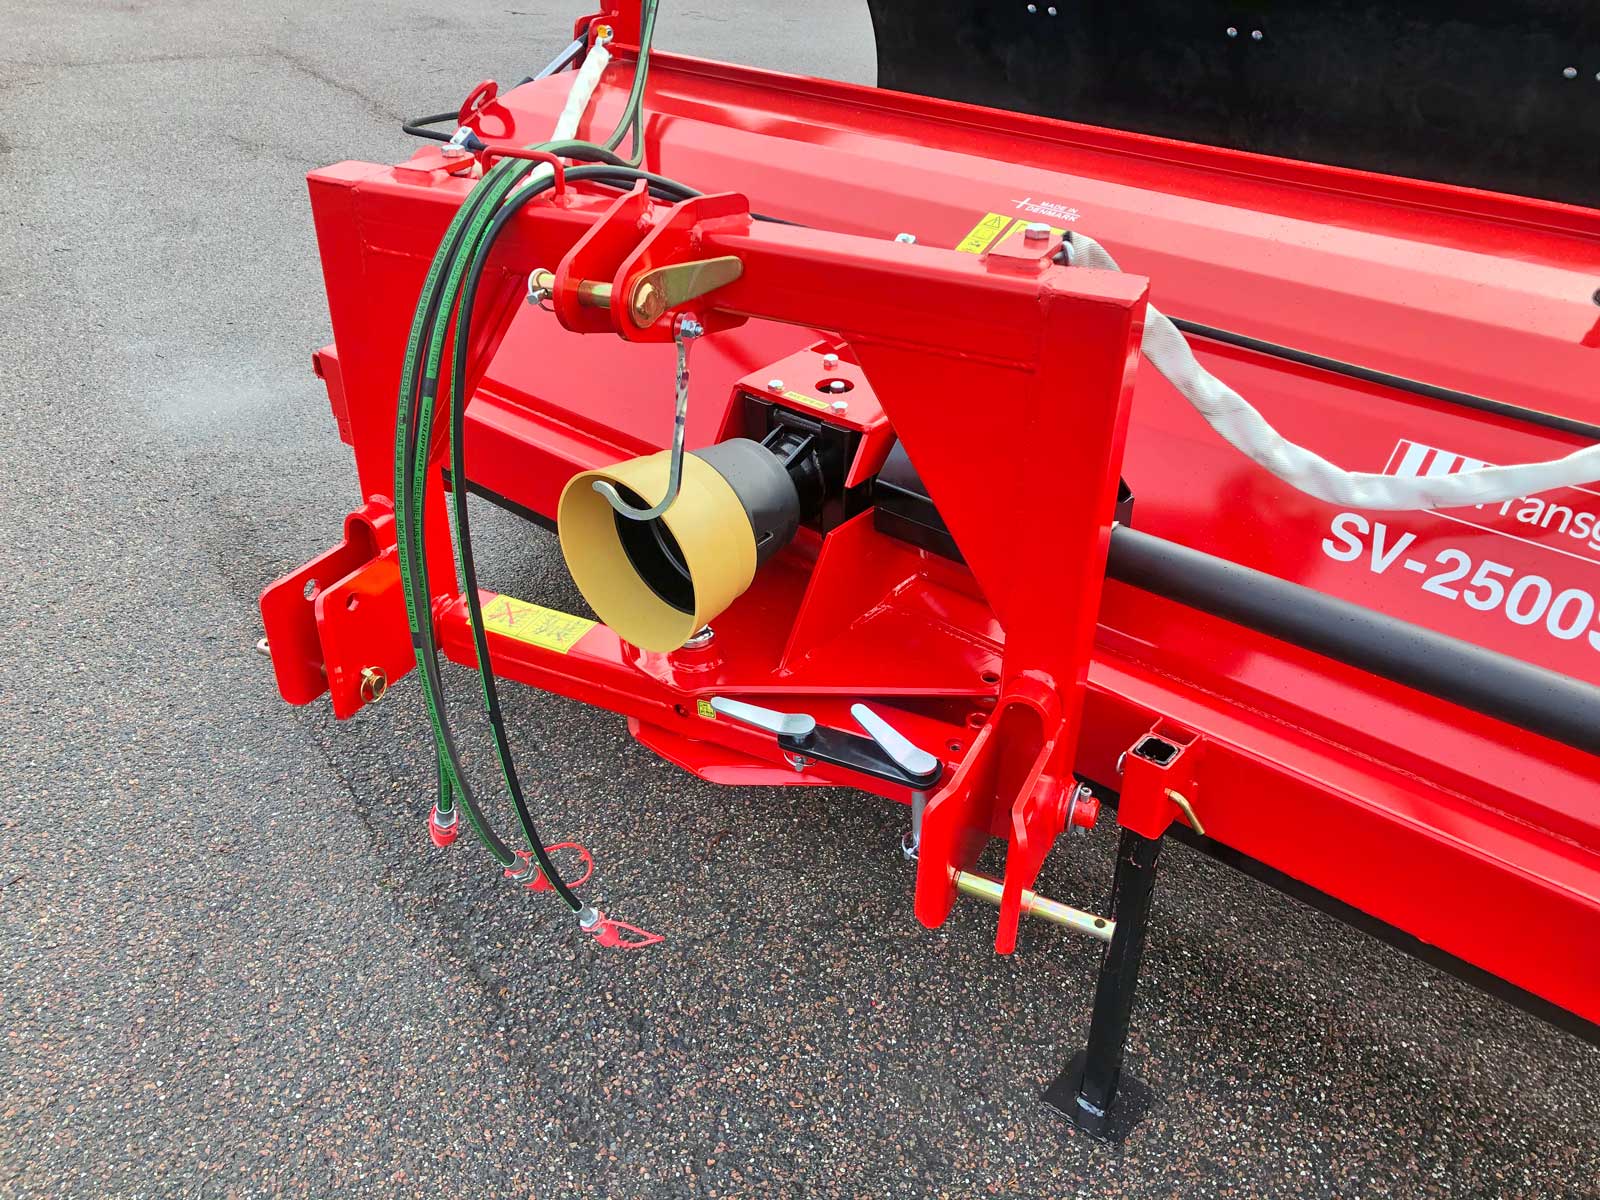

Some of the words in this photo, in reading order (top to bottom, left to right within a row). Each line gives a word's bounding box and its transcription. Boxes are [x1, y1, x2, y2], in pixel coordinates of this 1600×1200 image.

[1025, 206, 1078, 222] DENMARK
[1040, 201, 1068, 211] MADE
[452, 254, 466, 280] ARGUS
[417, 304, 427, 318] WP
[436, 314, 448, 338] MADE
[408, 335, 417, 352] BAR
[434, 339, 441, 348] IN
[429, 350, 440, 372] ITALY
[402, 354, 414, 392] EXCEEDS
[396, 466, 403, 478] WP
[396, 499, 404, 512] PSI
[397, 519, 405, 545] ARGUS
[403, 577, 412, 598] MADE
[407, 599, 414, 607] IN
[408, 608, 417, 628] ITALY
